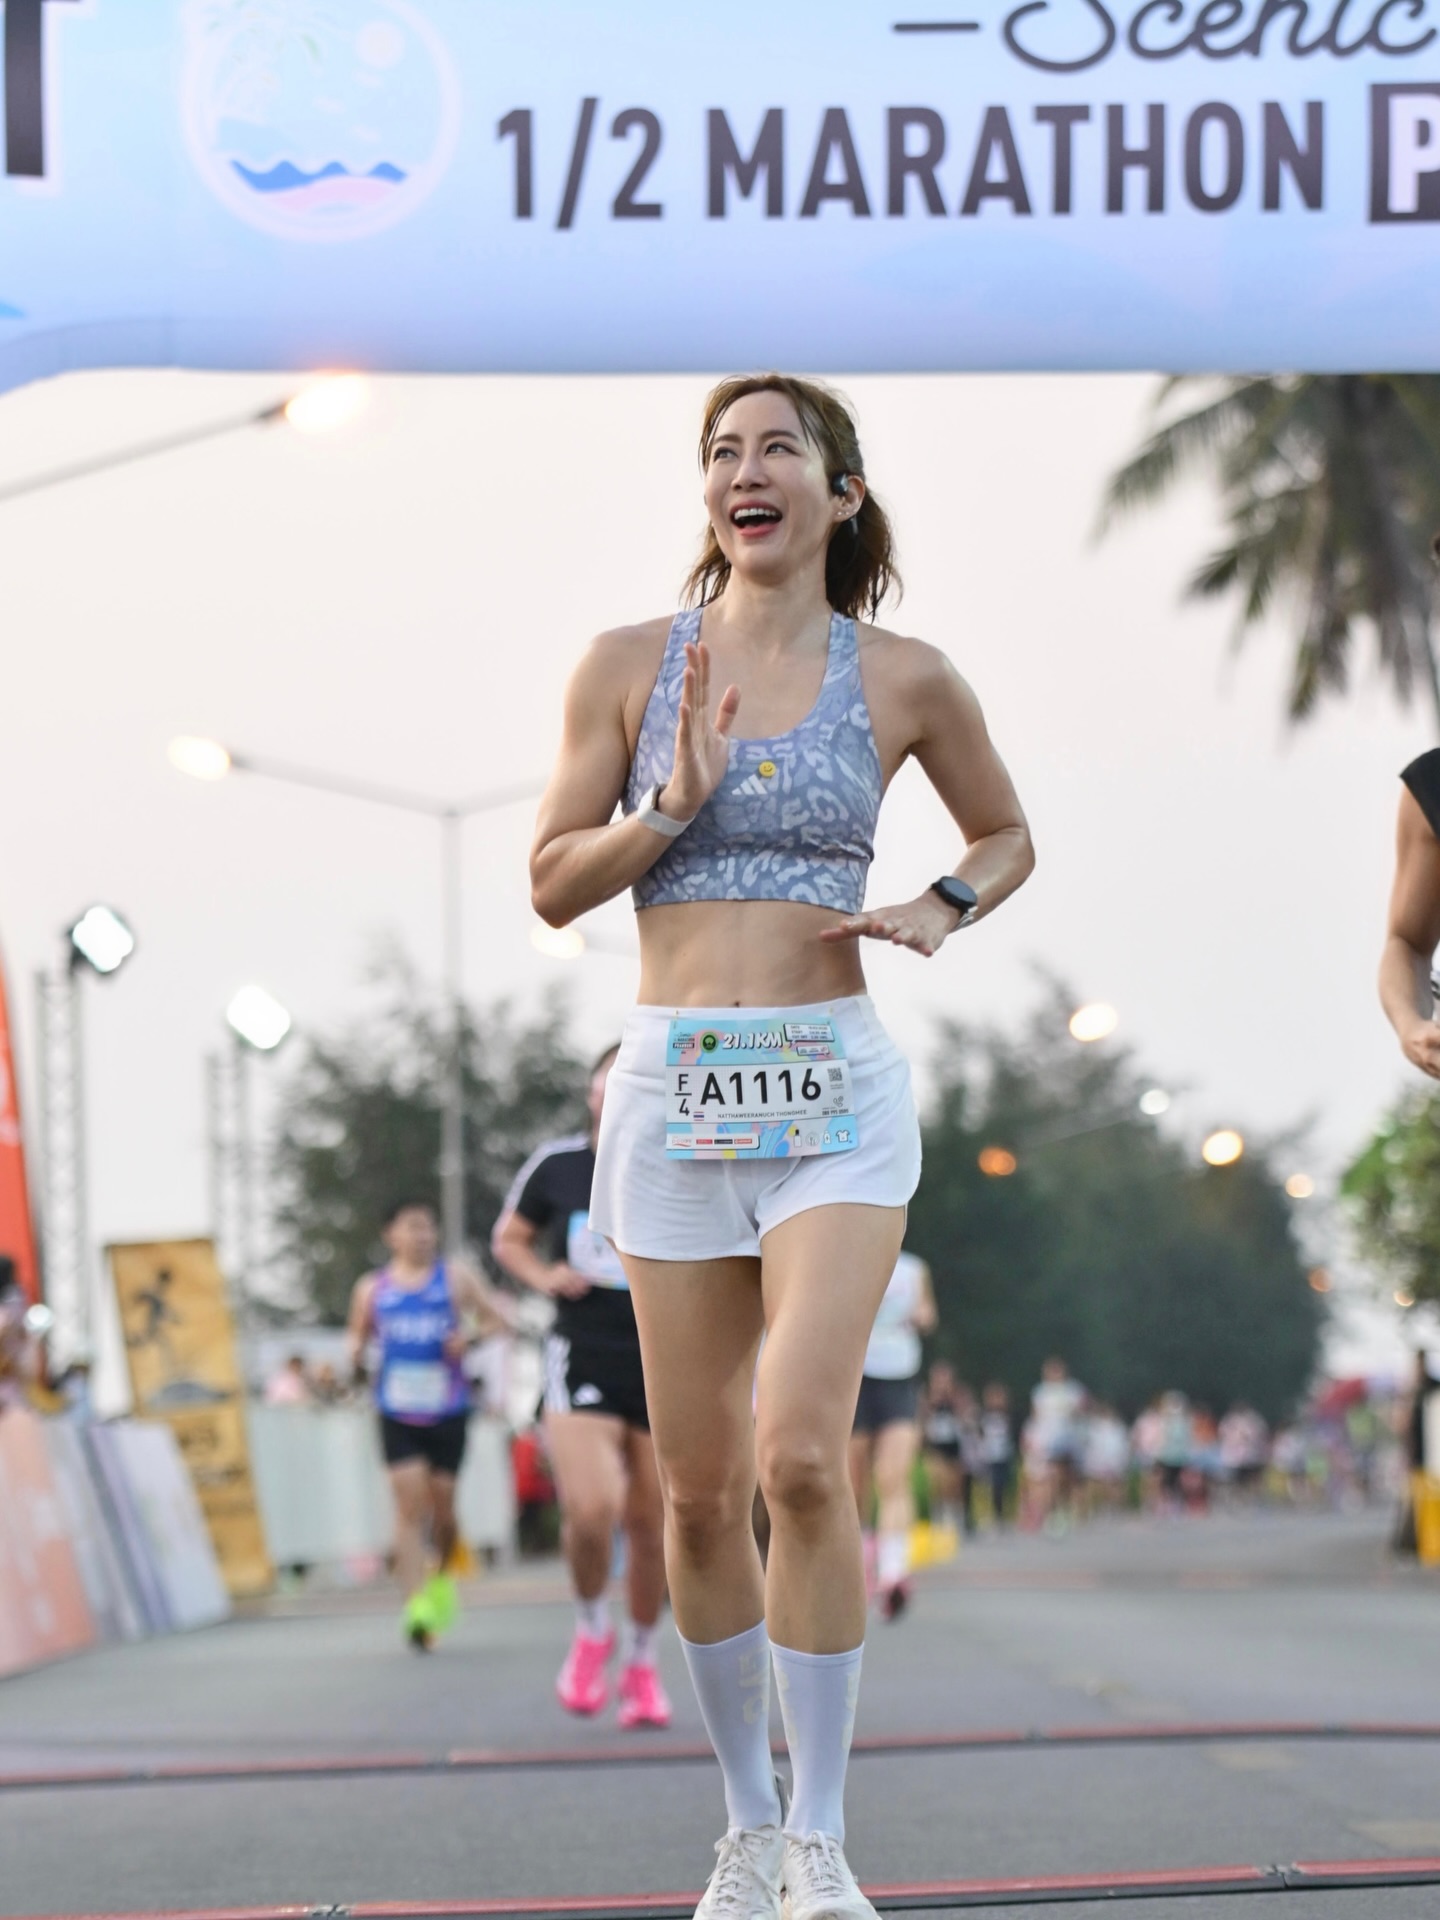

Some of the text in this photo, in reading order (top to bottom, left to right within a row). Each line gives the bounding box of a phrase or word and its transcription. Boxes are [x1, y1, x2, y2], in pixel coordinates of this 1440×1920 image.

[496, 97, 663, 231] 1/2
[706, 101, 1325, 220] MARATHON
[722, 1032, 784, 1050] 21.1KM
[678, 1074, 689, 1091] F
[700, 1068, 821, 1105] A1116
[679, 1098, 690, 1116] 4
